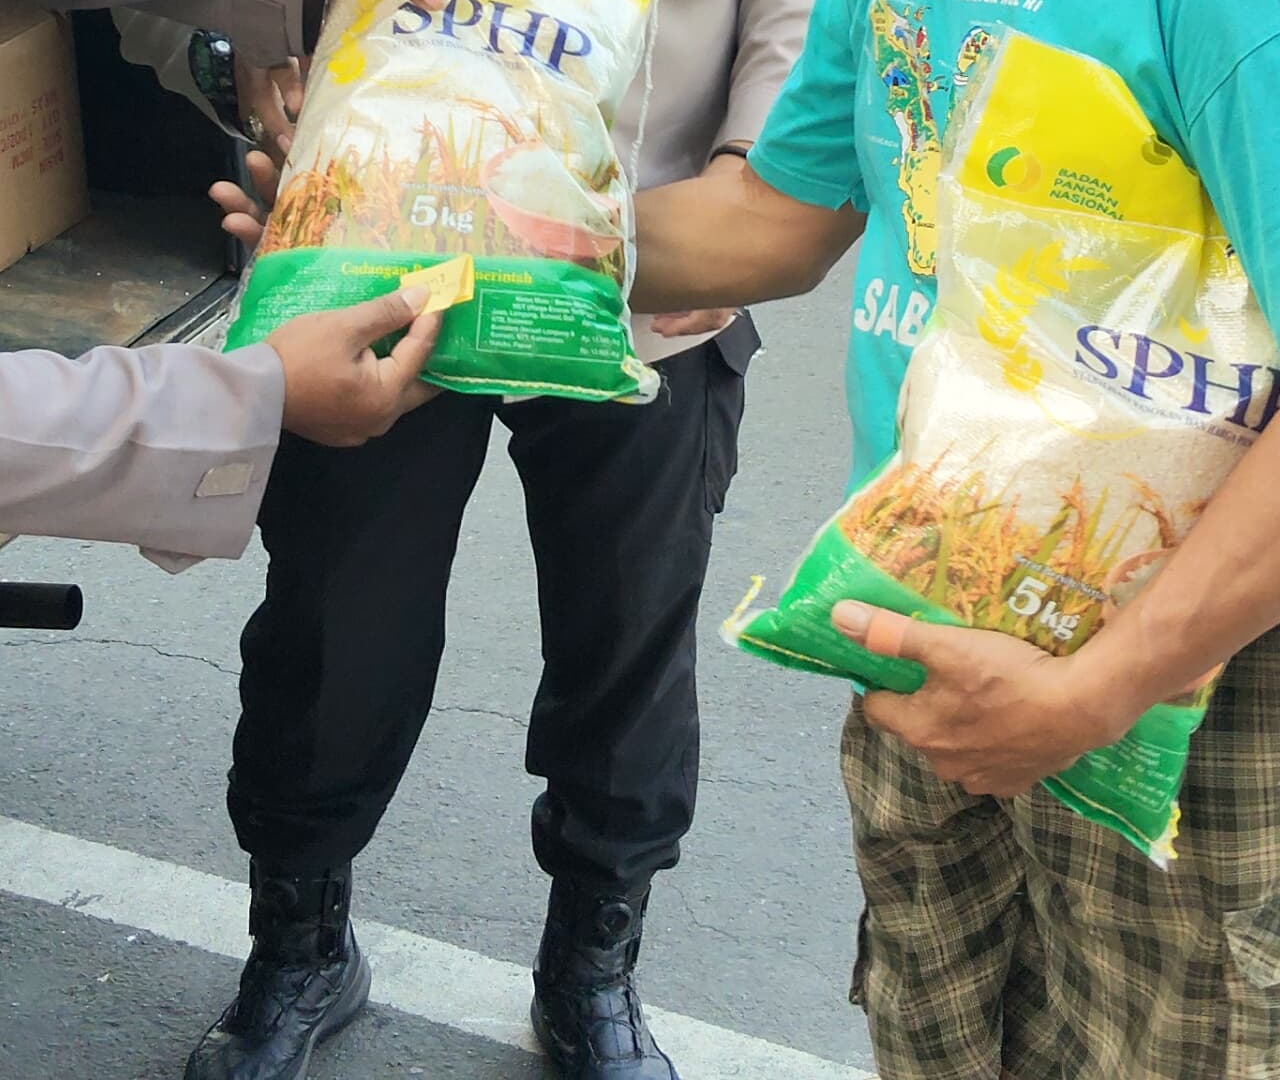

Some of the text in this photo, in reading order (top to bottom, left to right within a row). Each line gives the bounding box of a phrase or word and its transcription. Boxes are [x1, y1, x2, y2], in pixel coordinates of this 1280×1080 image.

[1054, 178, 1119, 207] PANGAN
[1058, 168, 1112, 192] BADAN
[410, 195, 474, 233] 5 kg
[342, 263, 407, 279] Cadangan
[1008, 576, 1048, 616] 5
[1040, 601, 1080, 640] kg
